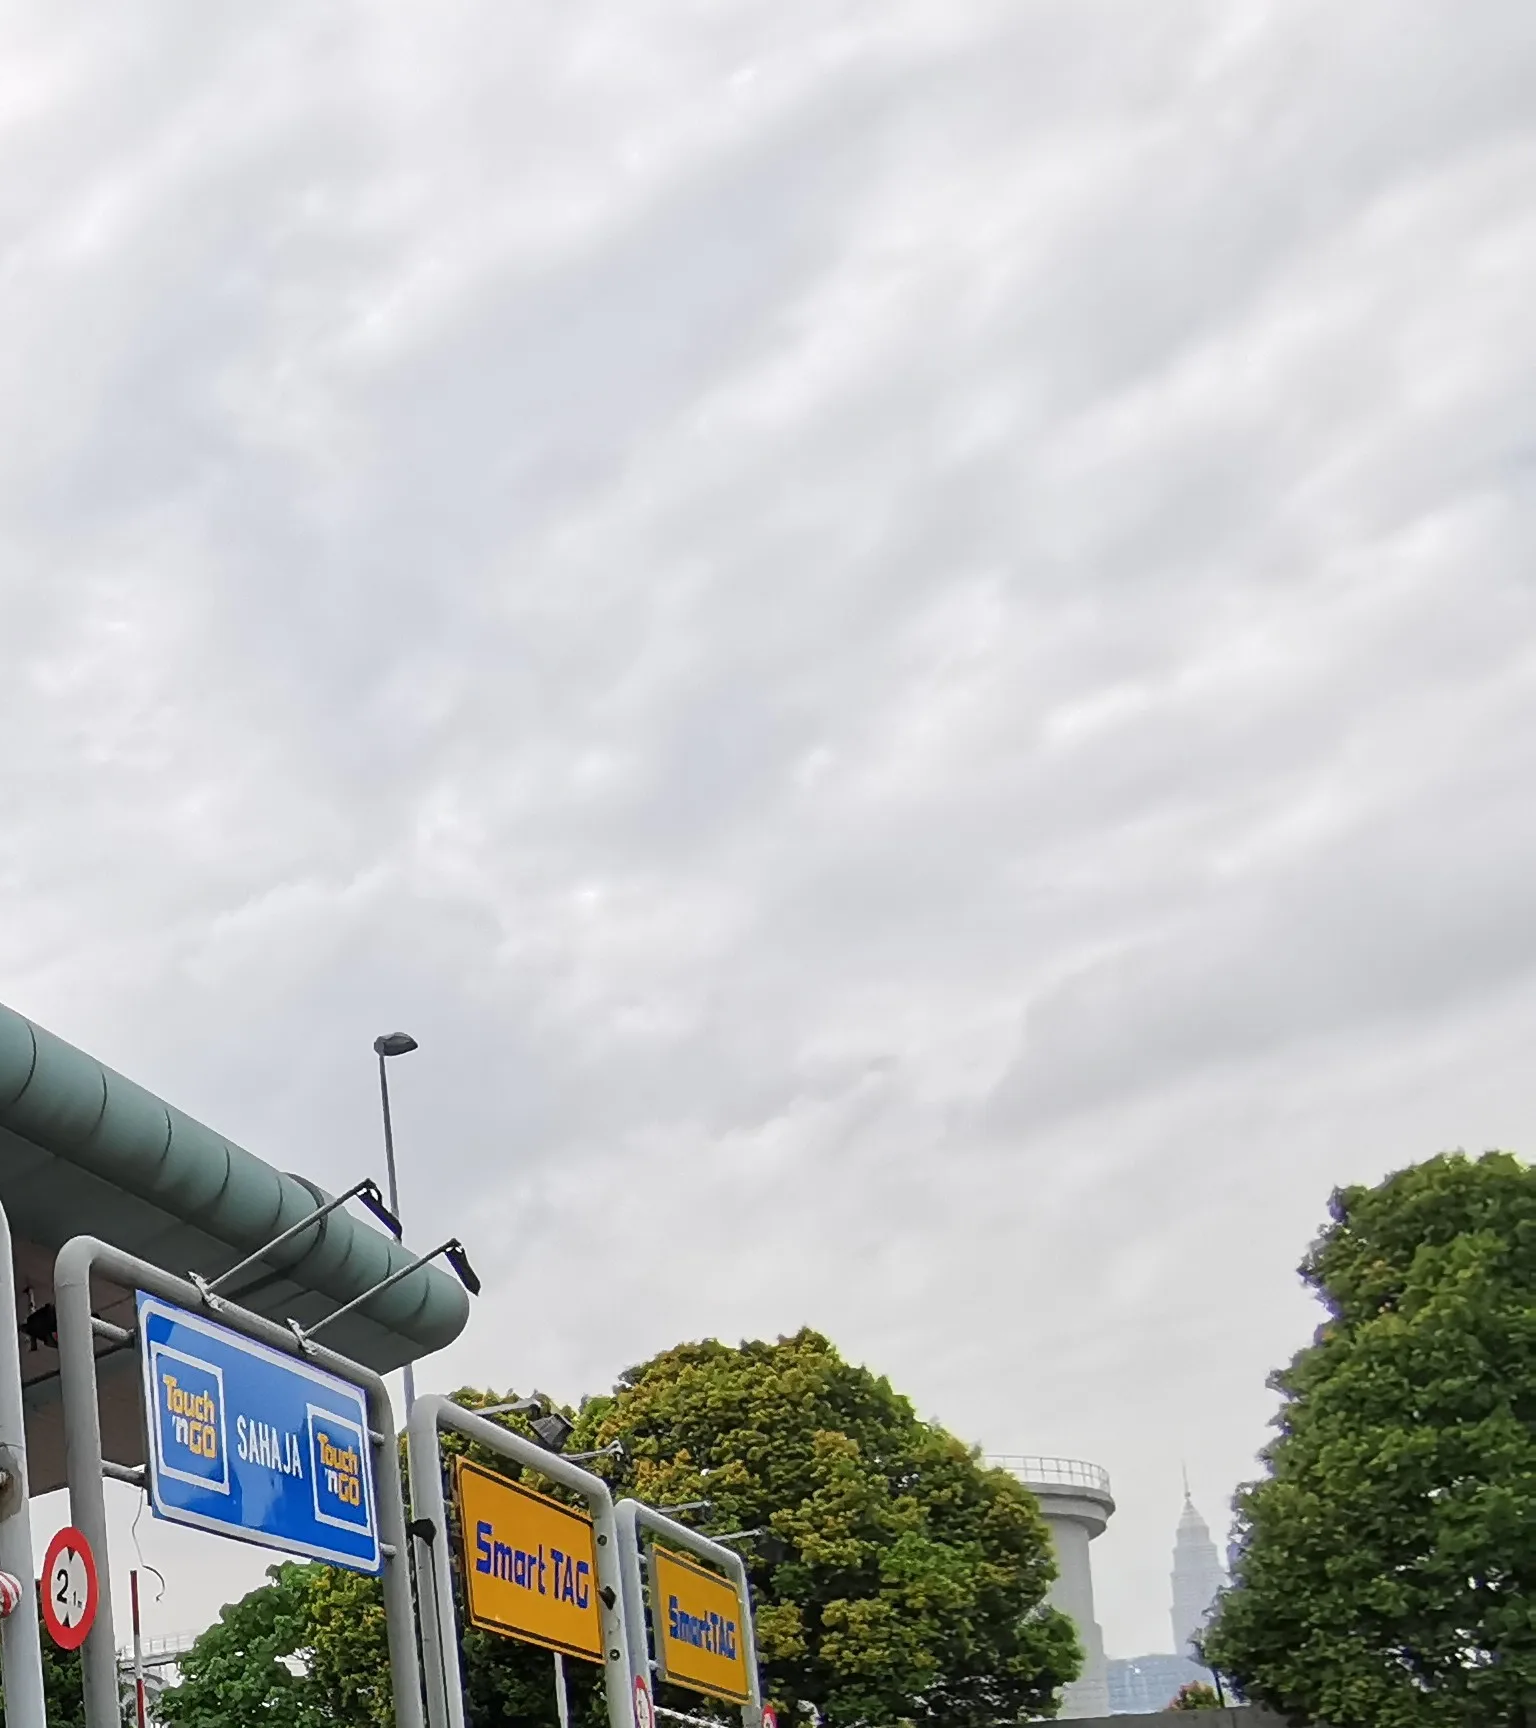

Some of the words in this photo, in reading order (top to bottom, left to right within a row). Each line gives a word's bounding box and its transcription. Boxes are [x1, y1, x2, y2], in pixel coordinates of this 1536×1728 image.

[163, 1374, 215, 1424] Touch
[237, 1415, 303, 1479] SAHAJA
[317, 1432, 358, 1475] Touch
[476, 1520, 546, 1595] Smart
[550, 1547, 589, 1609] TAG
